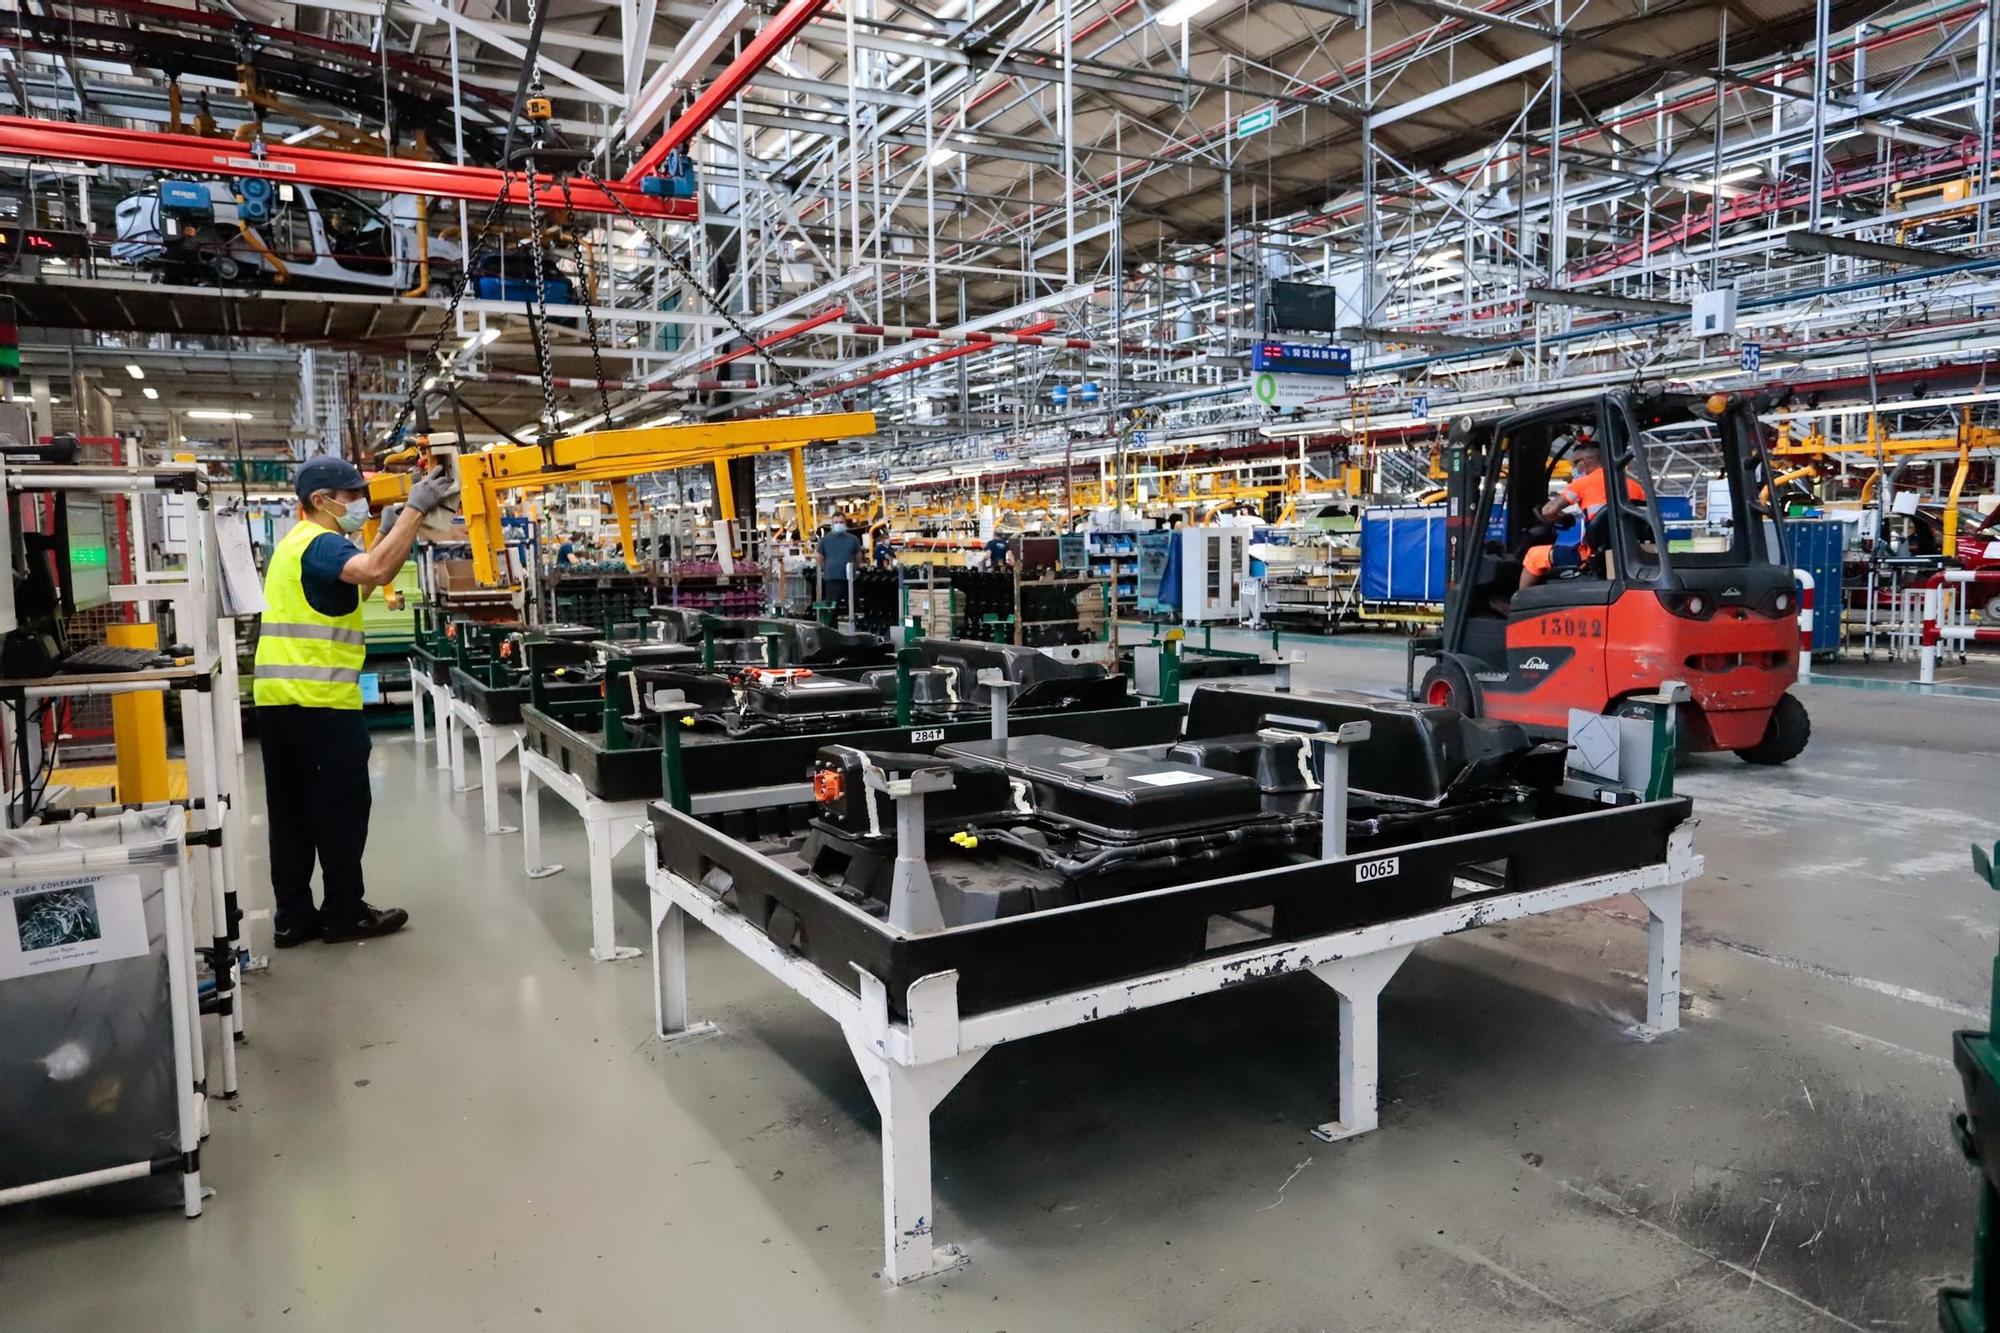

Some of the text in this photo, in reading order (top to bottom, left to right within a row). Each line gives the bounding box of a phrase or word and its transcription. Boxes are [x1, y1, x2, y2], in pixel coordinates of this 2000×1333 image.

[1742, 346, 1759, 371] 55
[1412, 397, 1427, 418] 54
[1133, 432, 1146, 447] 53
[879, 469, 889, 480] 51
[1541, 617, 1602, 638] 13022
[1519, 656, 1549, 670] Linde
[1360, 859, 1394, 880] 0065
[15, 885, 36, 895] este
